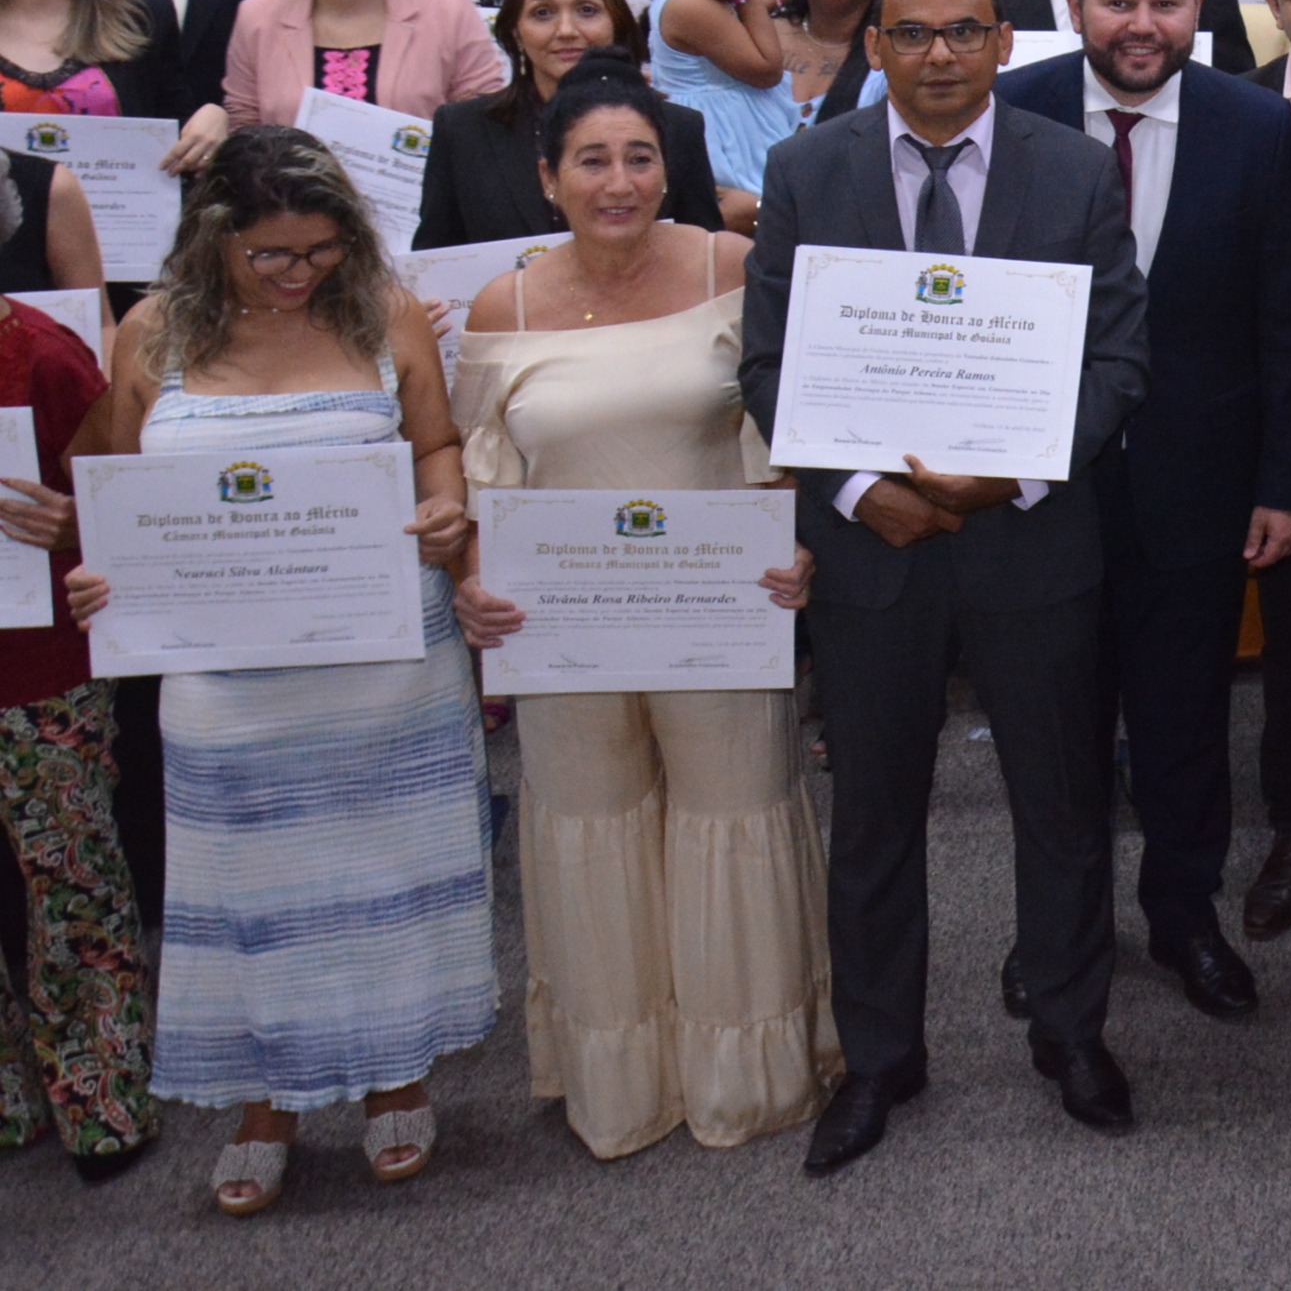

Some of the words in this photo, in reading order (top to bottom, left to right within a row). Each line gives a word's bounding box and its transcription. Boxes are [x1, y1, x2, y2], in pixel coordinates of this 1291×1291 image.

[840, 305, 896, 320] Diploma
[901, 310, 915, 322] de
[921, 310, 963, 325] Honra
[968, 318, 983, 327] ao
[988, 316, 1034, 330] Mérito
[859, 324, 898, 336] Câmara
[901, 328, 953, 340] Municipal
[956, 332, 967, 341] de
[970, 333, 1011, 344] Goiânia
[861, 364, 906, 375] Antônio
[910, 366, 952, 378] Pereira
[956, 369, 995, 380] Ramos
[137, 514, 202, 528] Diploma
[208, 514, 223, 524] de
[229, 511, 278, 524] Honra
[284, 512, 300, 521] ao
[306, 507, 358, 521] Mérito
[162, 531, 208, 542] Câmara
[212, 529, 270, 541] Municipal
[274, 529, 286, 537] de
[290, 525, 335, 536] Goiânia
[536, 543, 597, 556] Diploma
[603, 545, 618, 554] de
[623, 543, 668, 556] Honra
[674, 546, 689, 555] ao
[694, 543, 743, 556] Mérito
[175, 568, 224, 579] Neuraci
[228, 567, 261, 577] Silva
[267, 565, 328, 575] Alcântara
[558, 559, 601, 569] Câmara
[606, 560, 659, 570] Municipal
[663, 561, 674, 569] de
[678, 559, 720, 568] Goiânia
[538, 595, 588, 604] Silvânia
[593, 595, 622, 604] Rosa
[627, 594, 671, 603] Ribeiro
[675, 594, 736, 603] Bernardes
